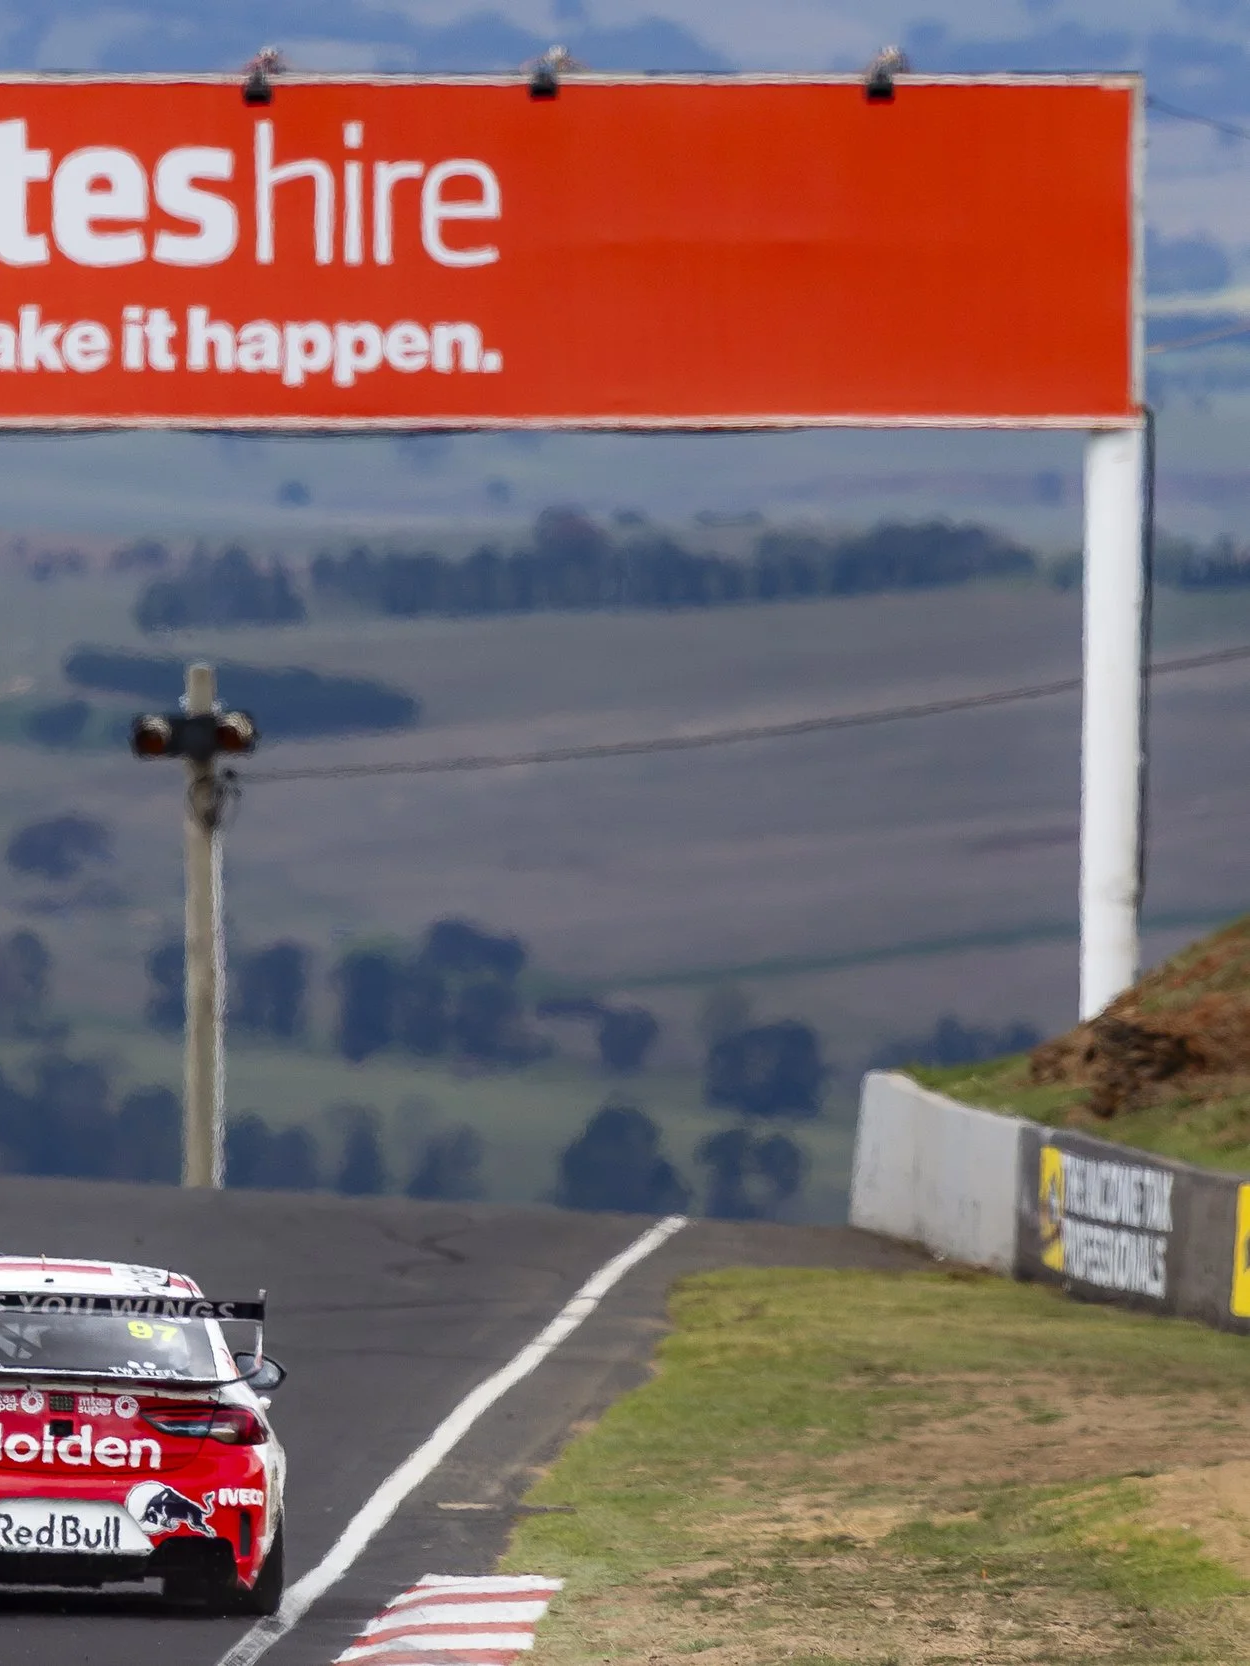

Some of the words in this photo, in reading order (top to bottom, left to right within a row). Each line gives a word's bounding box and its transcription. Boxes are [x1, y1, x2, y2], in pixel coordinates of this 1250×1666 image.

[254, 119, 501, 268] hire
[121, 305, 178, 372] it
[186, 305, 503, 388] happen.
[19, 1295, 95, 1314] YOU
[109, 1298, 235, 1319] WINGS
[127, 1320, 179, 1342] 97
[77, 1405, 113, 1417] super
[62, 1515, 121, 1550] Bull
